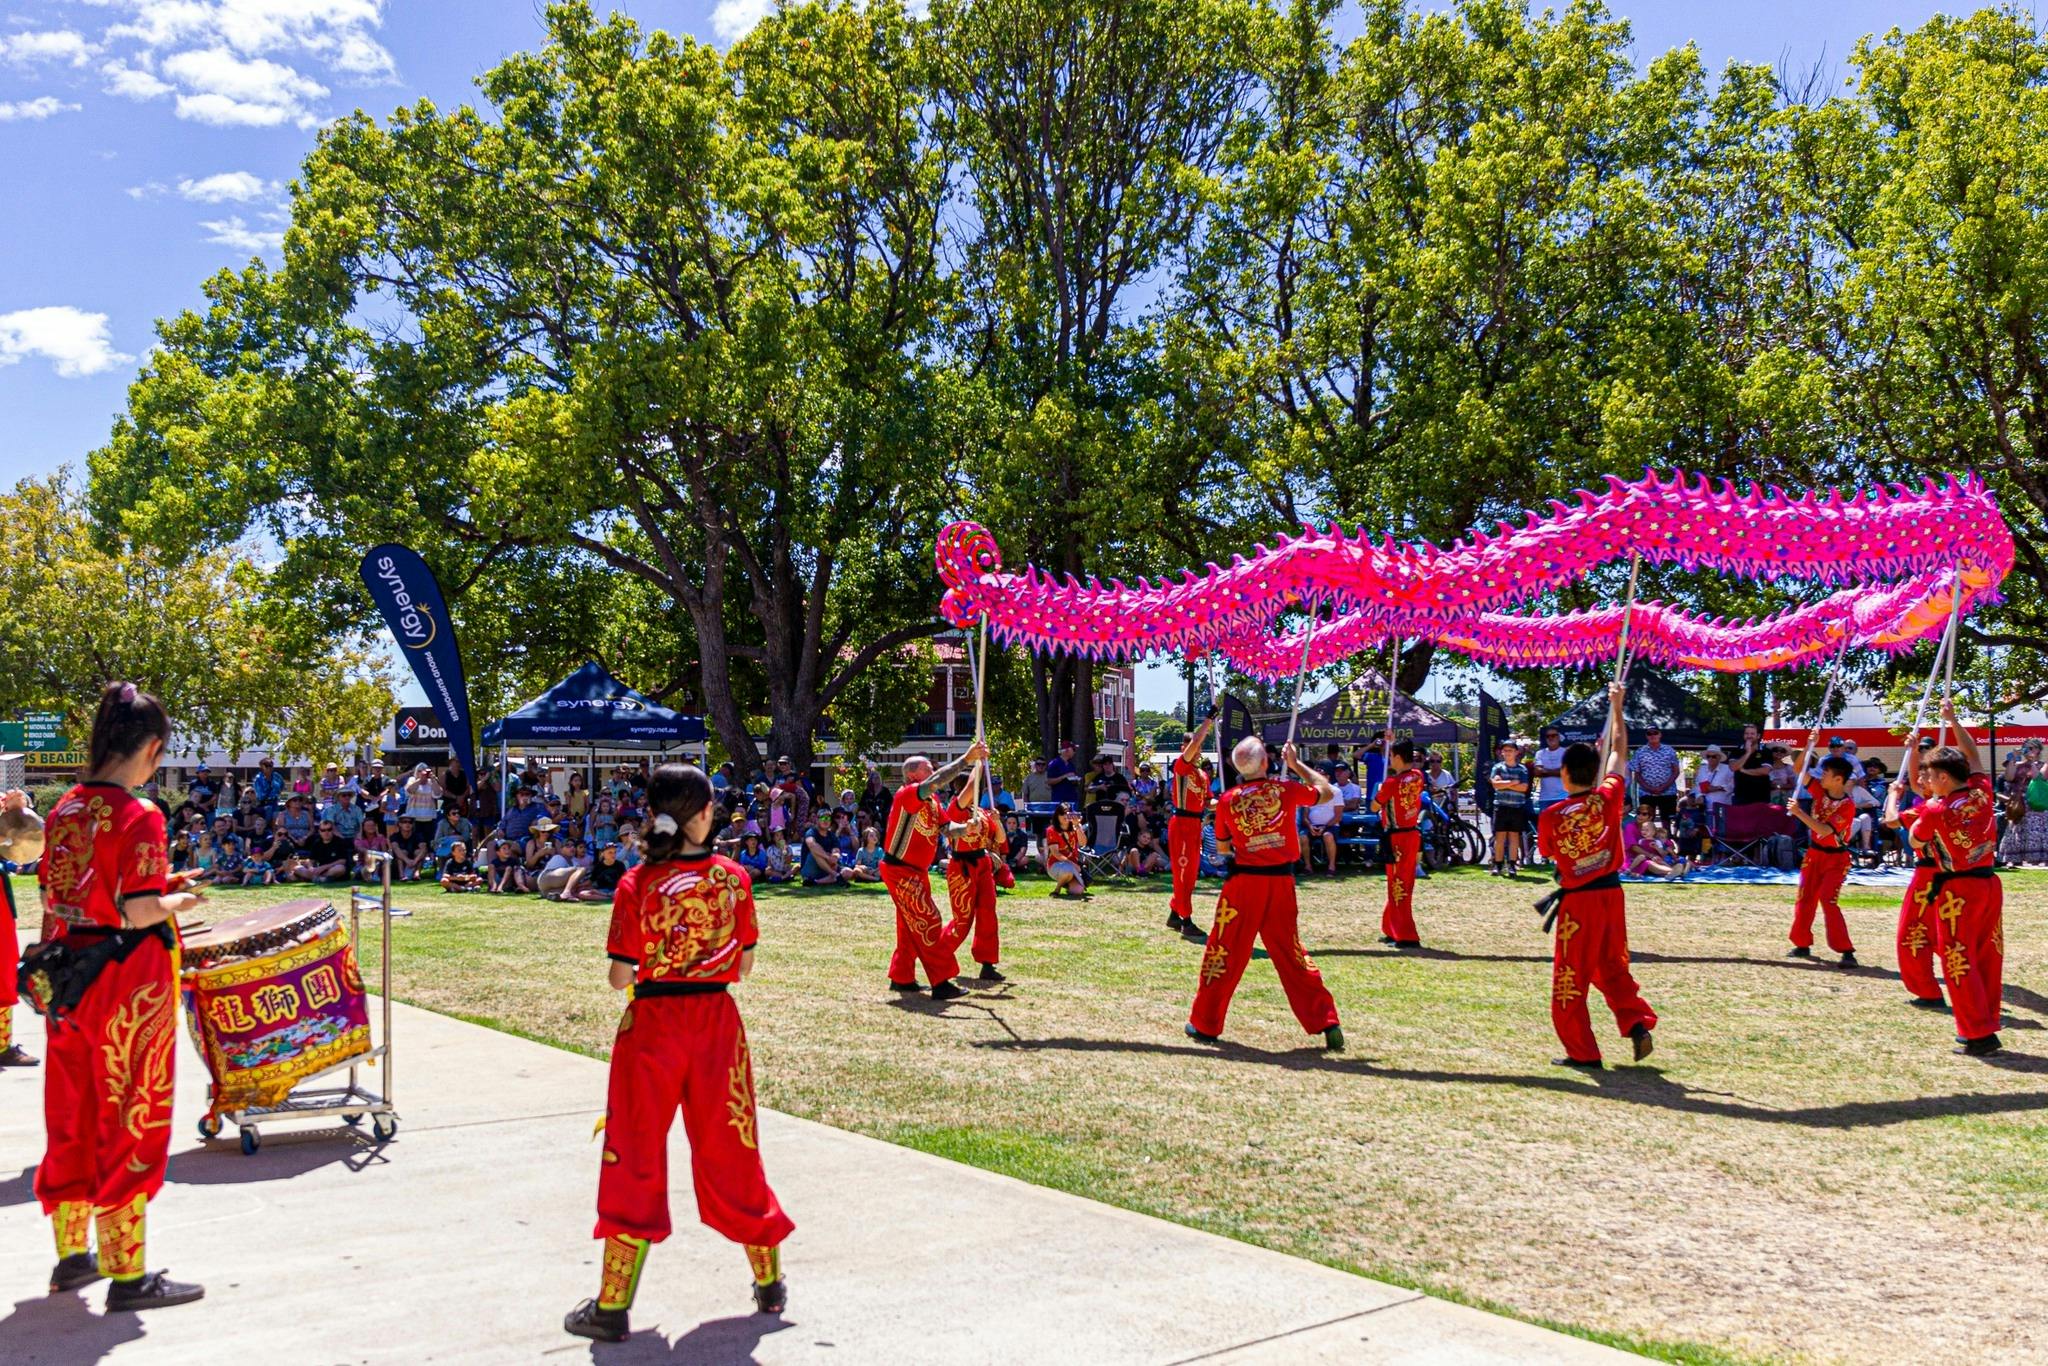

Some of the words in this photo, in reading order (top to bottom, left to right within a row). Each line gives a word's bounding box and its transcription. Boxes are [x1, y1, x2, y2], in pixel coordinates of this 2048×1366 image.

[378, 556, 427, 639] synergy
[425, 651, 441, 678] PROUD
[436, 677, 459, 722] SUPPORTER
[556, 699, 637, 711] synergy
[418, 725, 447, 739] Don
[531, 724, 581, 733] synergy.net.au
[630, 725, 678, 734] synergy.net.au
[1300, 726, 1355, 740] Worsley
